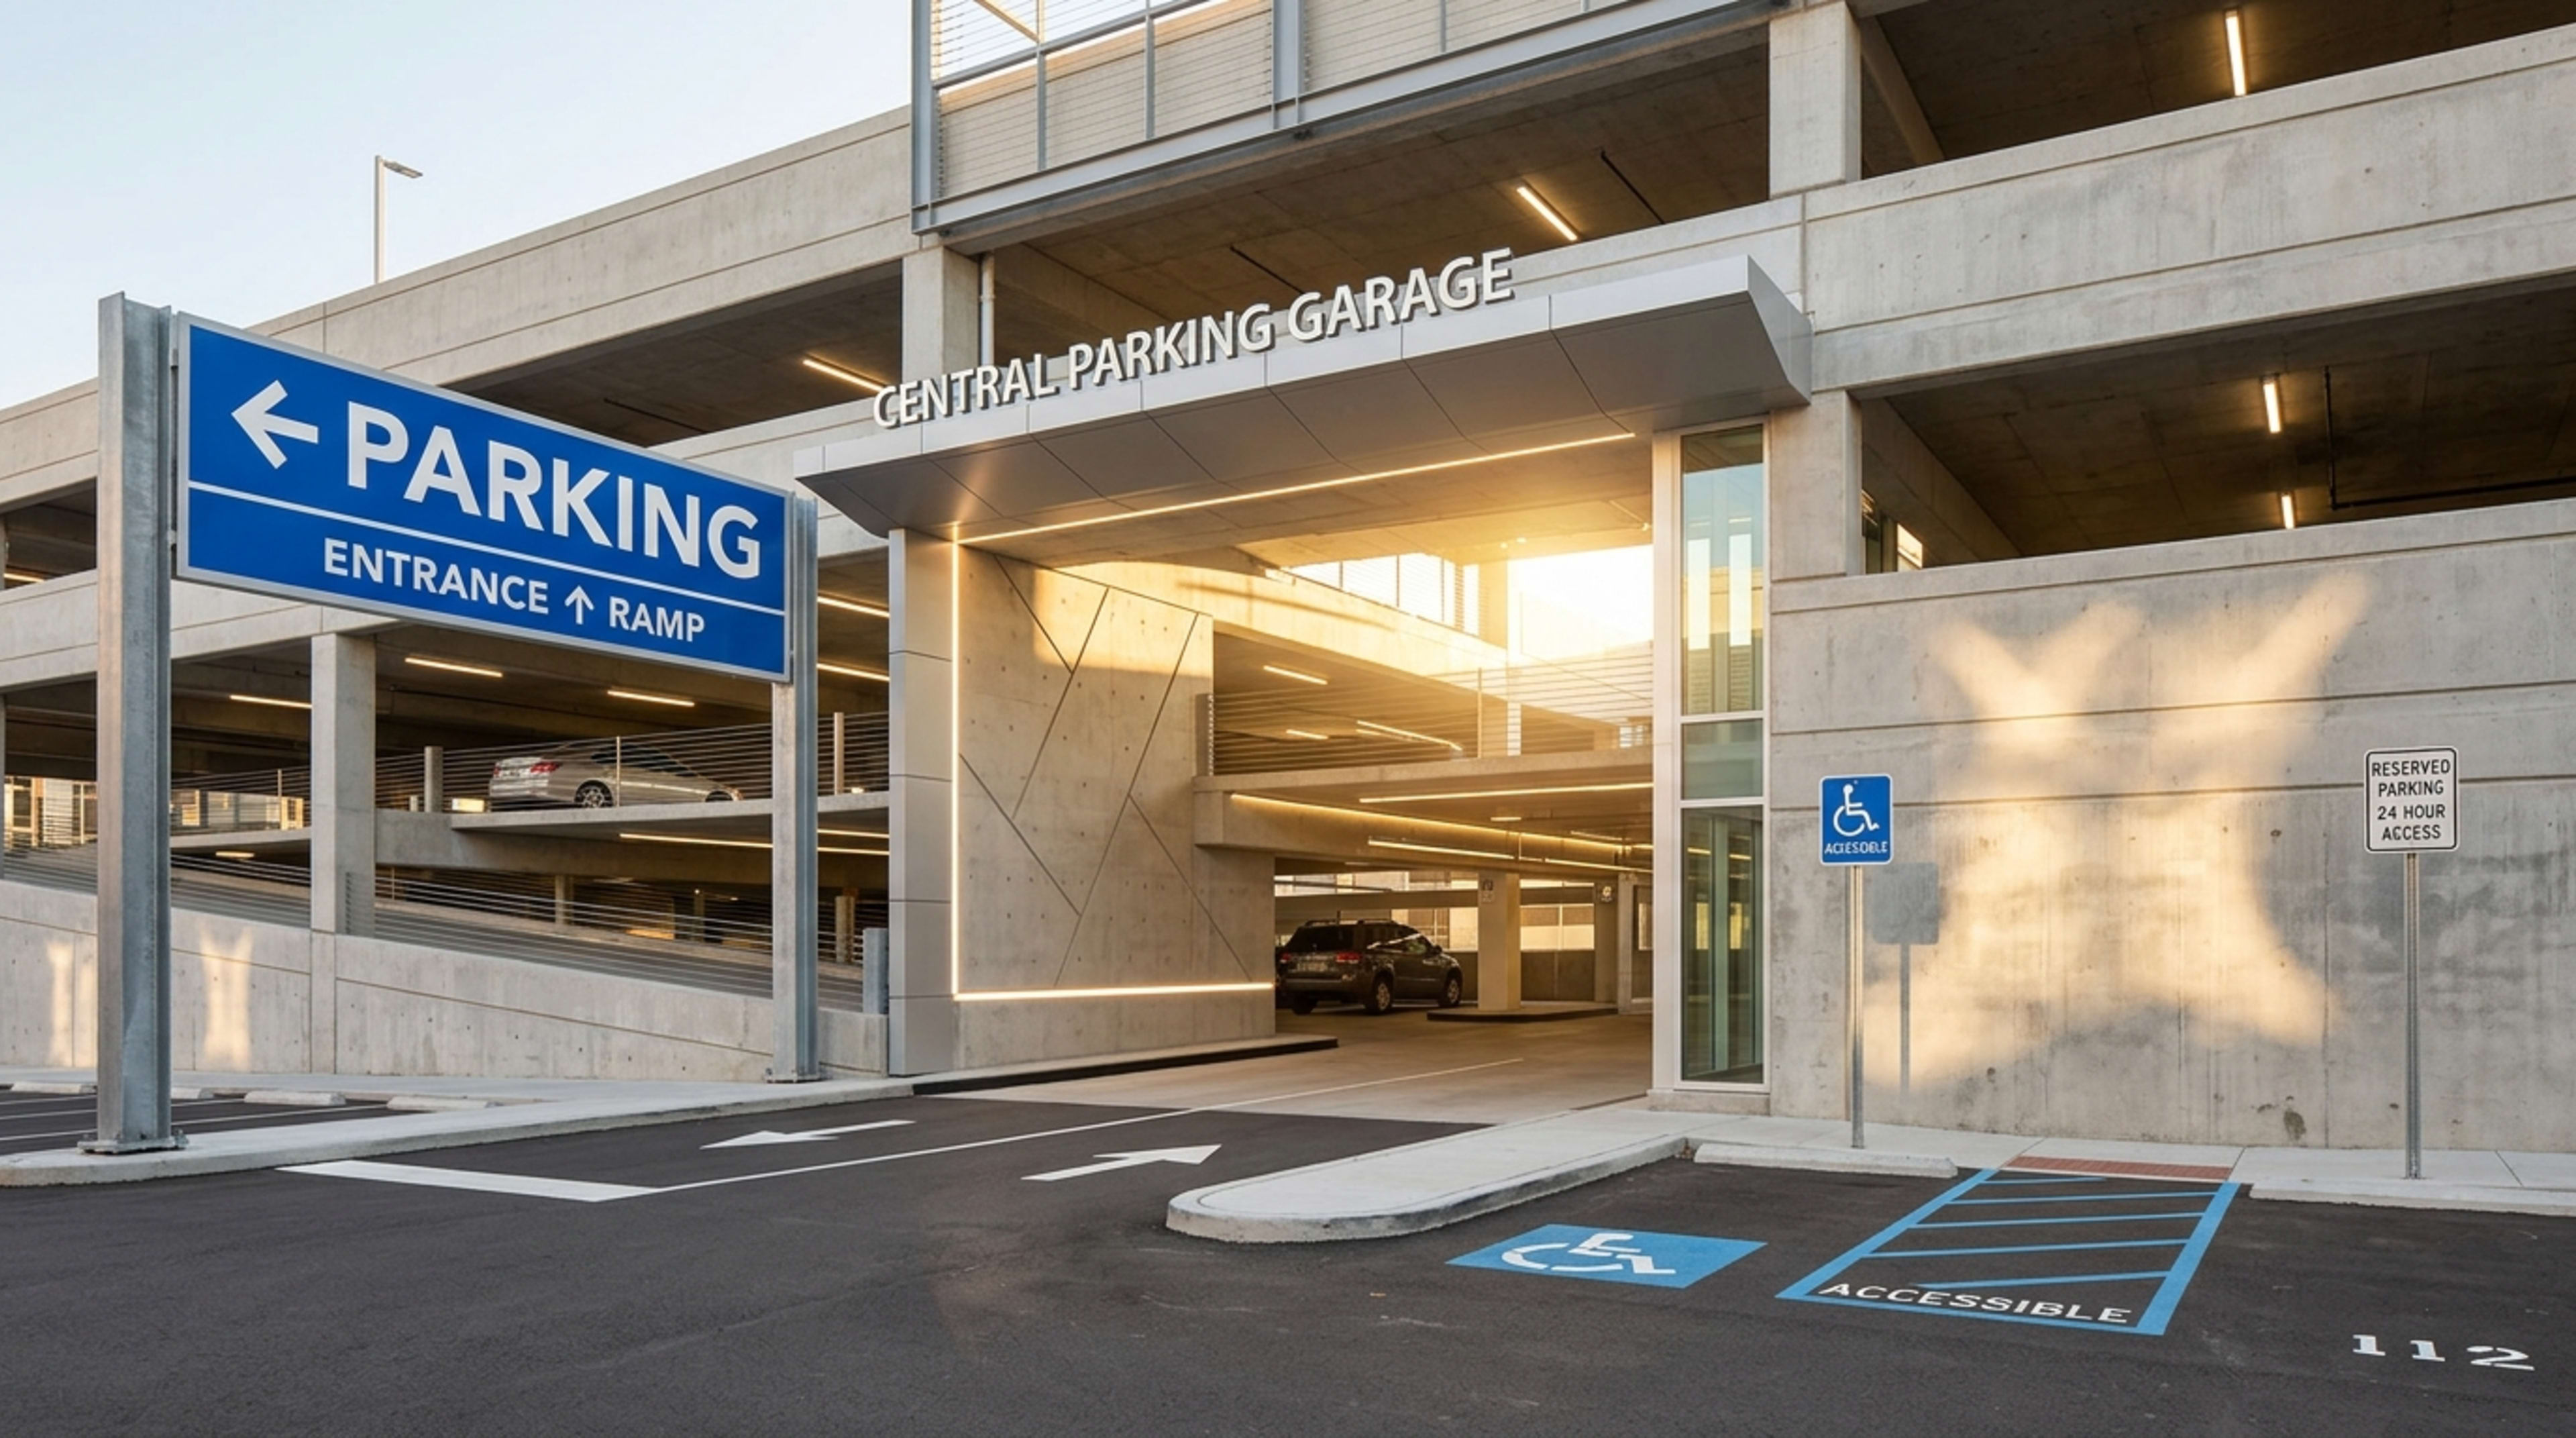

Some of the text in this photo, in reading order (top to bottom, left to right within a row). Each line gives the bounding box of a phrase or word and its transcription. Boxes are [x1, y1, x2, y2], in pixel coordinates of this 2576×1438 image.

[873, 247, 1515, 429] CENTRAL PARKING GARAGE
[348, 401, 760, 579] PARKING
[325, 537, 705, 642] ENTRANCE RAMP
[2378, 779, 2444, 797] PARKING
[2377, 803, 2446, 820] 24 HOUR
[2381, 824, 2442, 841] ACCESS
[1818, 1282, 2132, 1324] ACCESSIBLE
